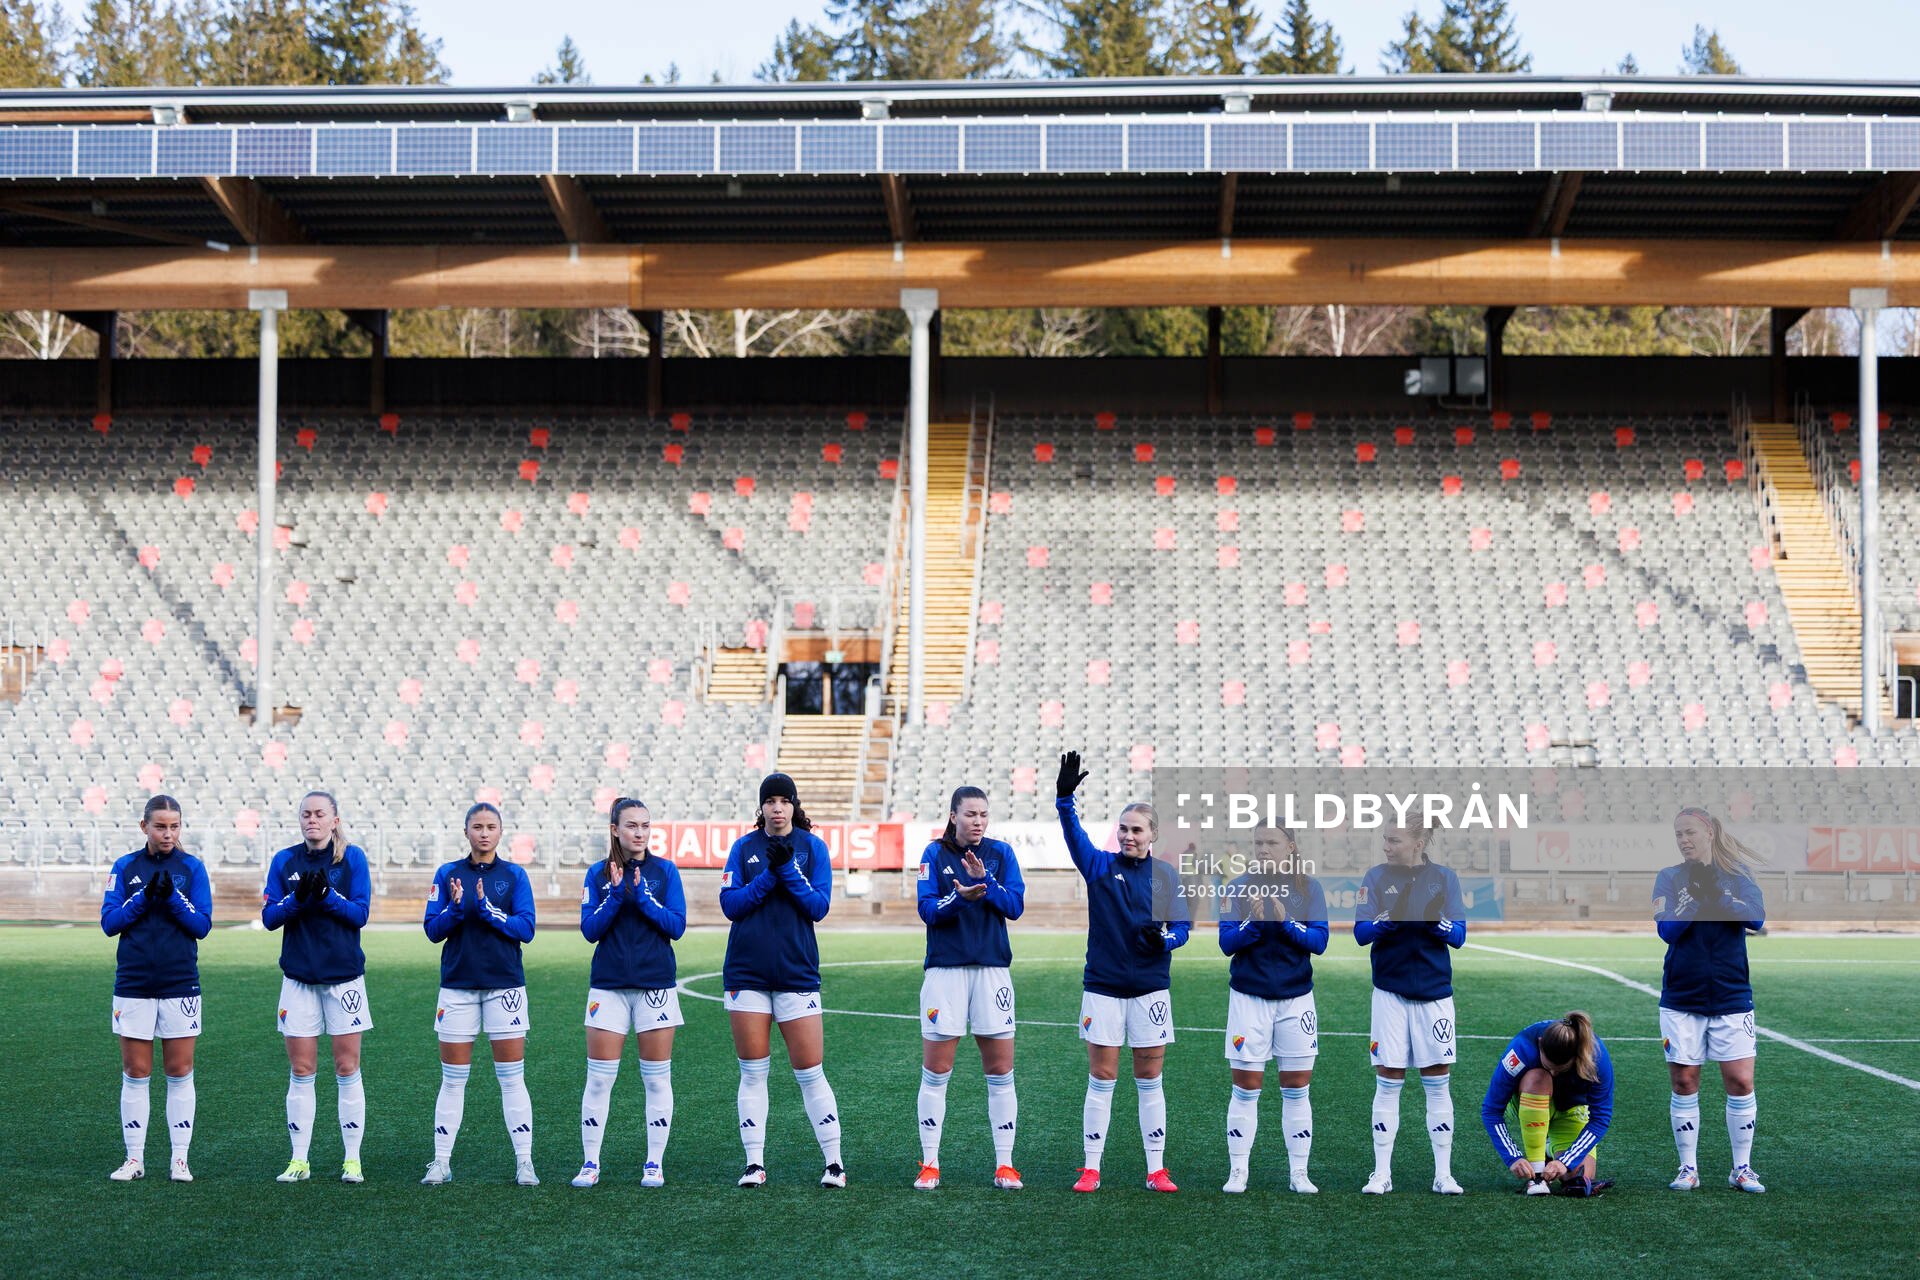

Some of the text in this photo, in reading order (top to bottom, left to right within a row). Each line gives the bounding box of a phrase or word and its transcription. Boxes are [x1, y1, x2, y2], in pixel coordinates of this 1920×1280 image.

[341, 990, 362, 1014] VW
[501, 989, 522, 1012] VW
[1149, 1001, 1167, 1025] VW
[1432, 1018, 1453, 1043] VW
